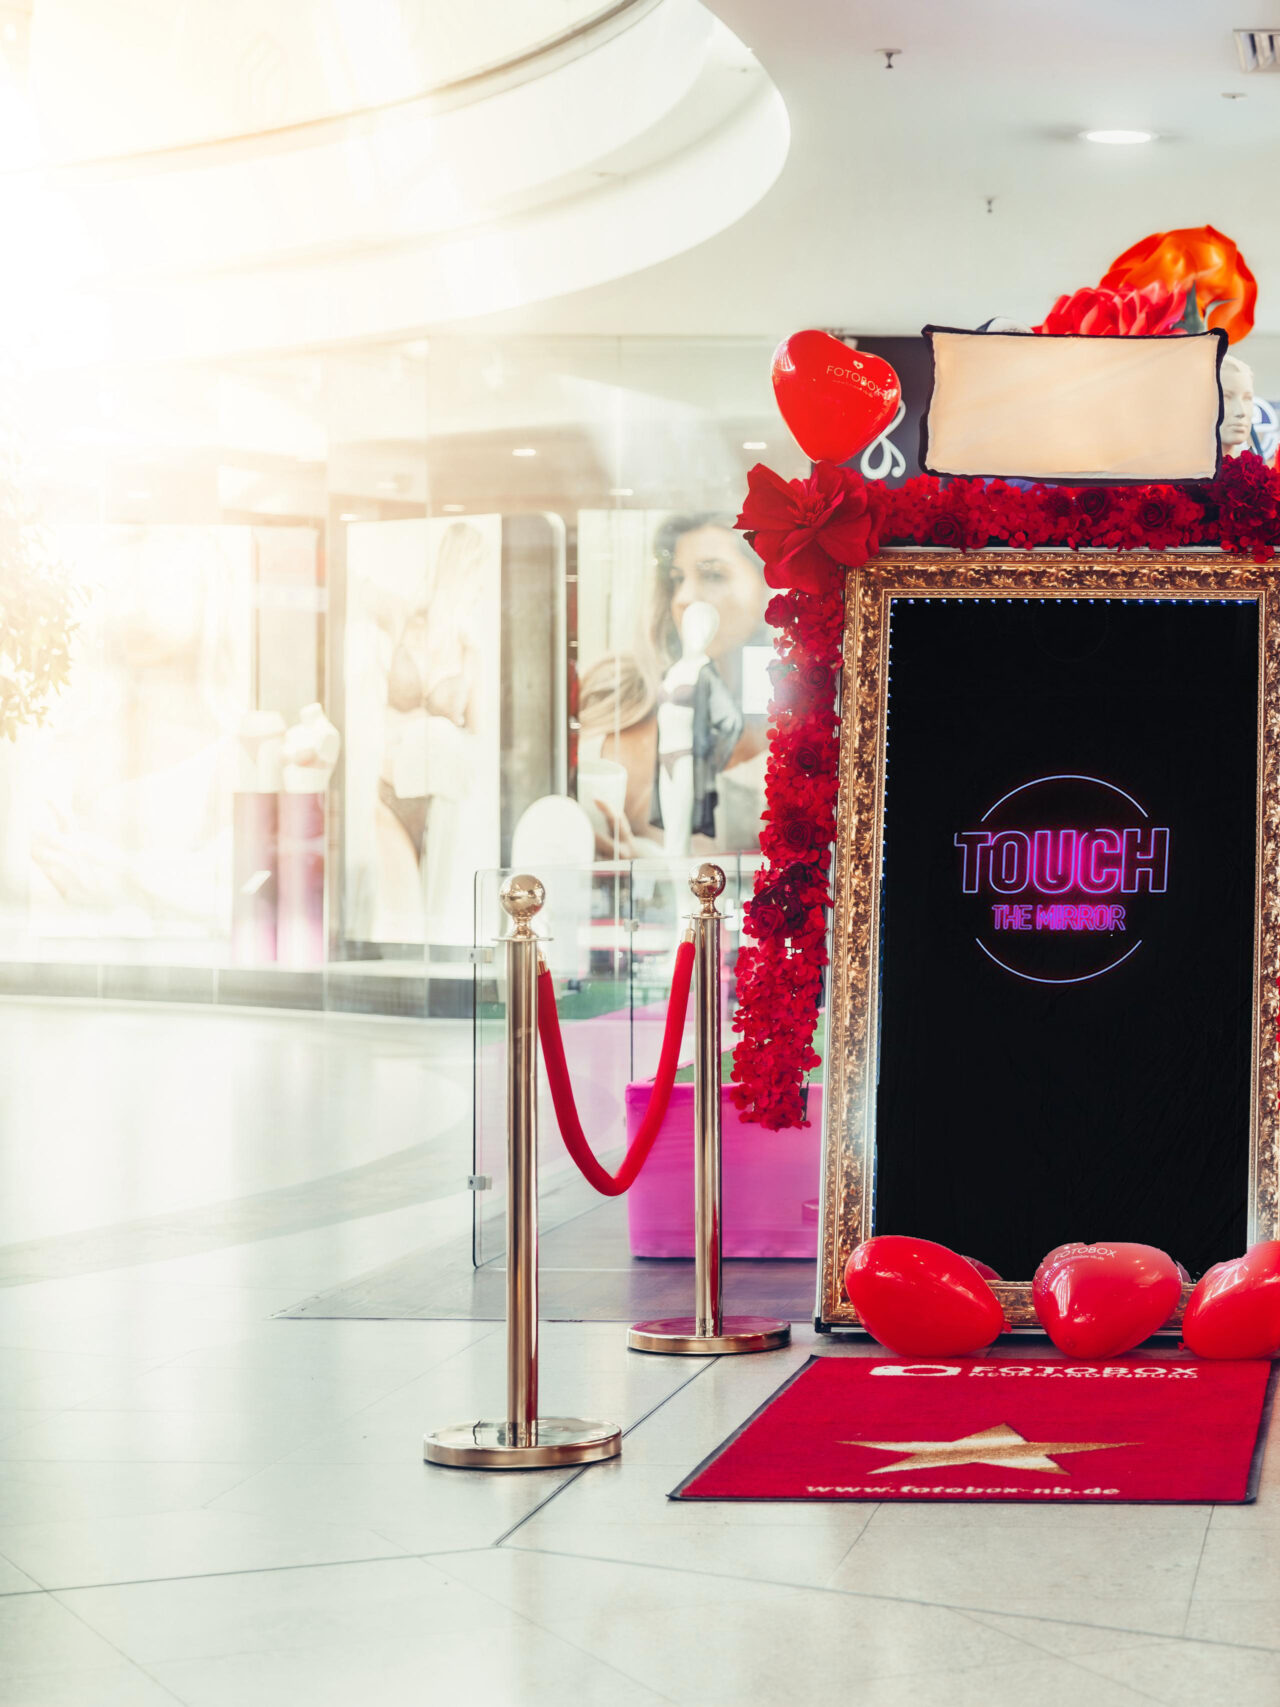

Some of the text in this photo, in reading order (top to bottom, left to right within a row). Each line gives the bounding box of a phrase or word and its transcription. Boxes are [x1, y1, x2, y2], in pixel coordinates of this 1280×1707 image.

[826, 365, 881, 397] FOTOBOX
[954, 827, 1170, 894] TOUCH
[991, 904, 1126, 931] THE MIRROR
[1053, 1246, 1118, 1262] FOTOBOX
[971, 1365, 1199, 1375] FOTOBOX
[805, 1485, 1121, 1495] www.fotobox-nb.de
